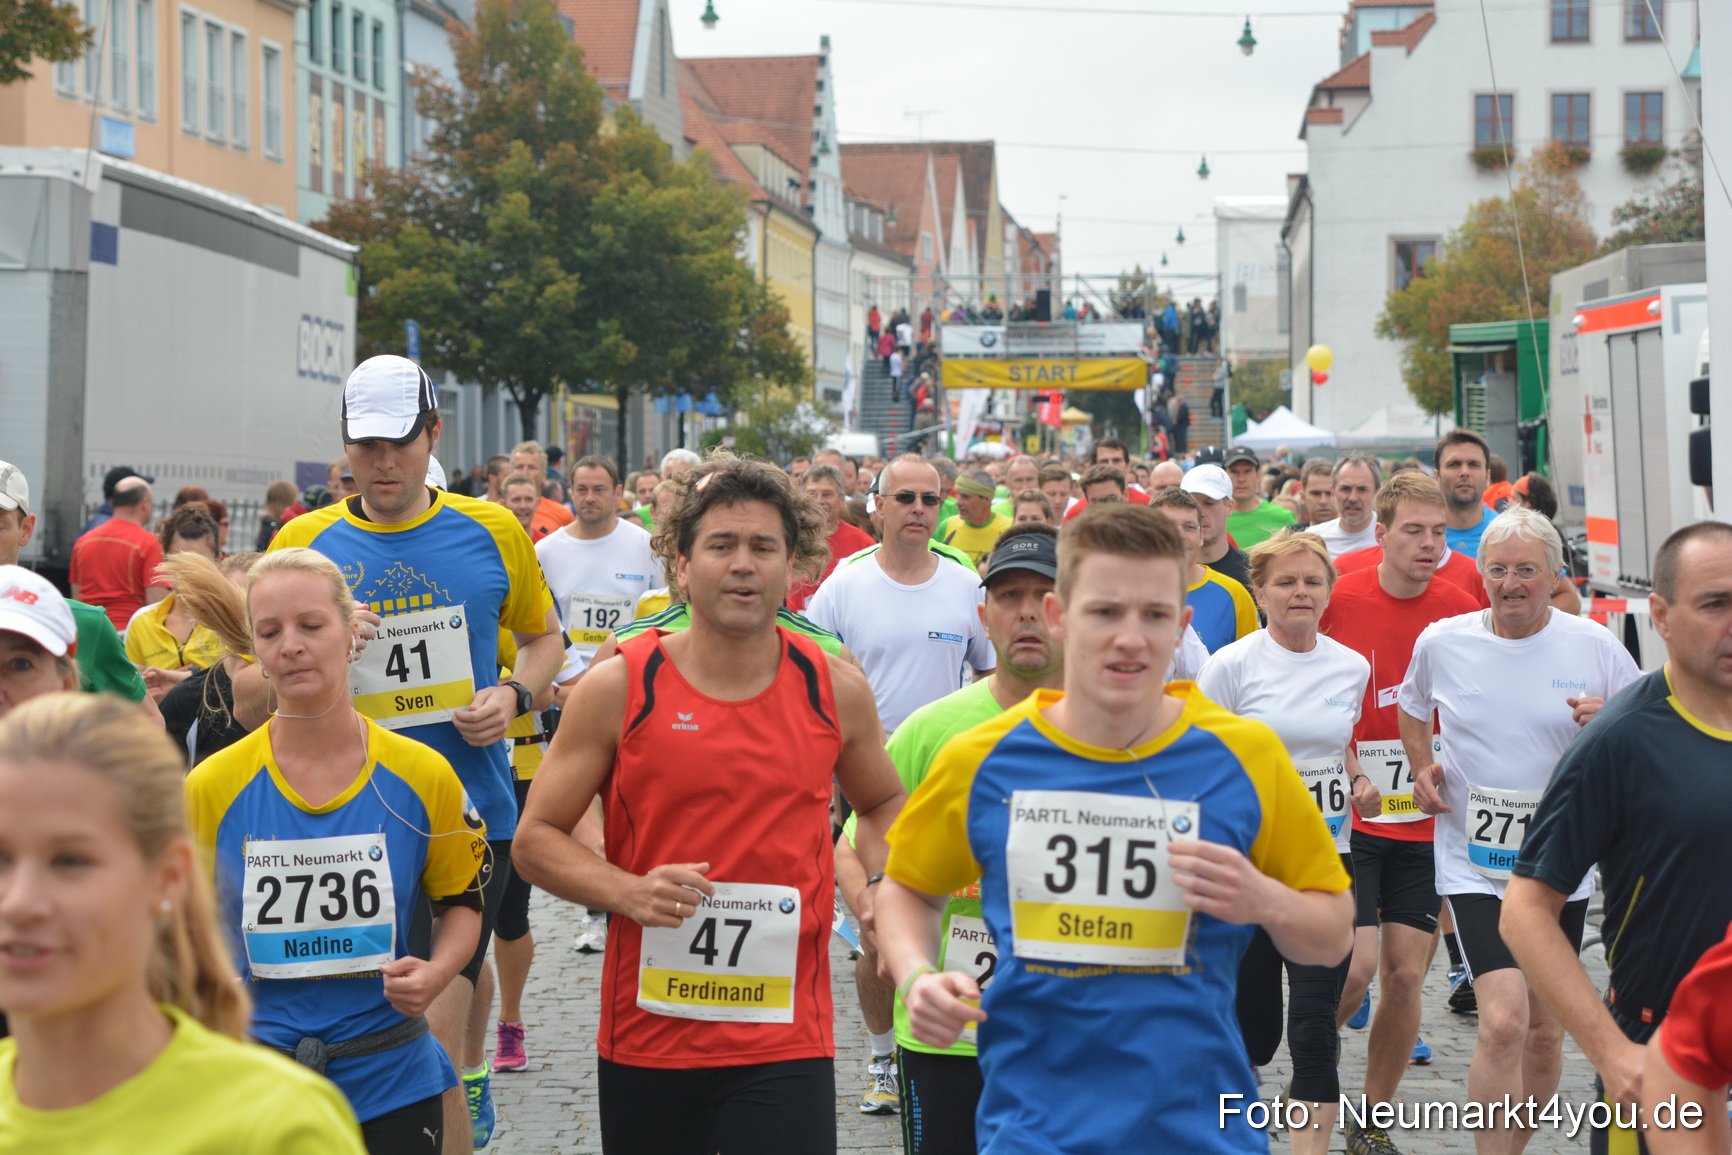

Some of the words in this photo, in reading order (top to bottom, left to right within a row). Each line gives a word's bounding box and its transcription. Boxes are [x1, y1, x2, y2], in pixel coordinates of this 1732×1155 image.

[1009, 365, 1080, 382] START
[583, 607, 620, 629] 192
[387, 621, 445, 639] Neumarkt
[385, 639, 431, 683] 41
[1552, 679, 1587, 691] Herbert
[394, 694, 435, 712] Sven
[672, 722, 699, 731] erima
[1359, 749, 1388, 758] PARTL
[1470, 793, 1499, 806] PARTL
[1015, 808, 1073, 825] PARTL
[1077, 810, 1166, 830] Neumarkt
[247, 854, 290, 868] PARTL
[293, 850, 364, 866] Neumarkt
[1044, 834, 1157, 899] 315
[256, 868, 380, 925] 2736
[701, 896, 773, 912] Neumarkt
[1058, 912, 1133, 940] Stefan
[689, 917, 752, 967] 47
[952, 927, 996, 945] PARTL
[284, 936, 353, 958] Nadine
[667, 977, 765, 1002] Ferdinand
